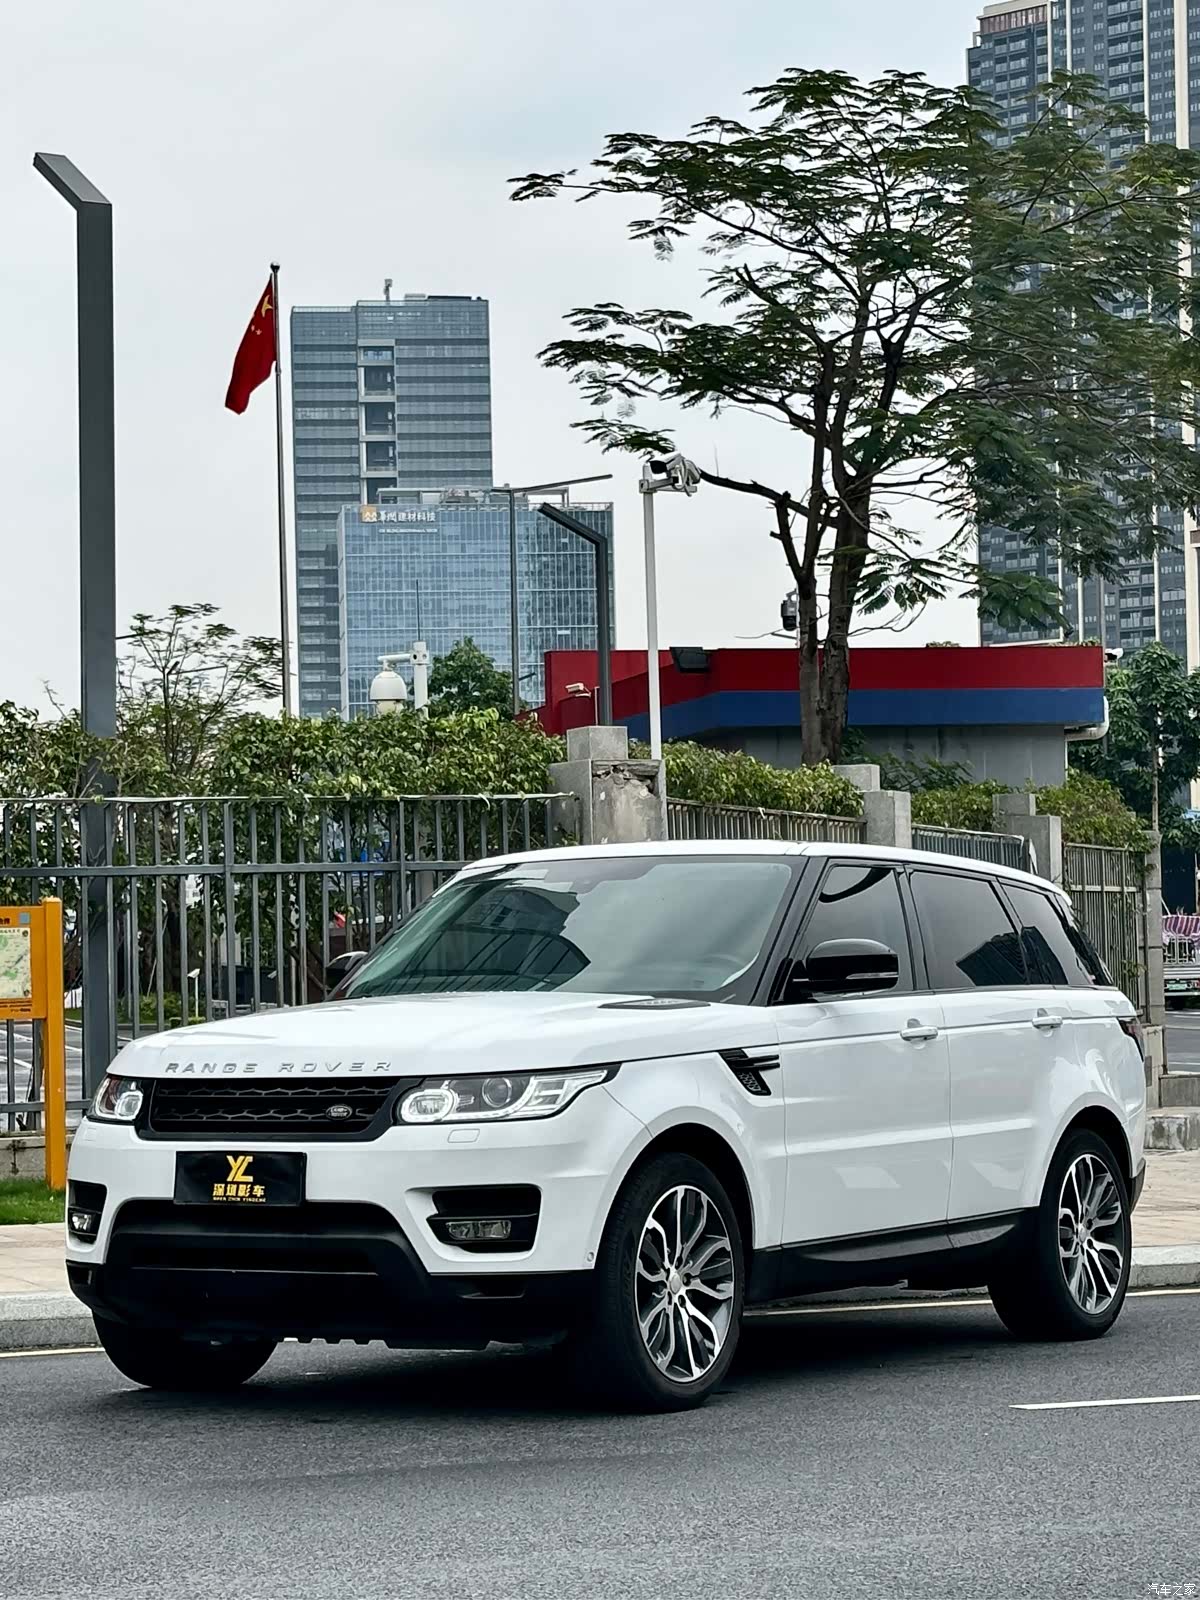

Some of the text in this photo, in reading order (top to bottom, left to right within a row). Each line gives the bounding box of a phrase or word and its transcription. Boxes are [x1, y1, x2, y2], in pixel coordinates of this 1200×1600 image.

[165, 1061, 392, 1074] RANGE ROVER
[212, 1183, 266, 1197] 深圳影车
